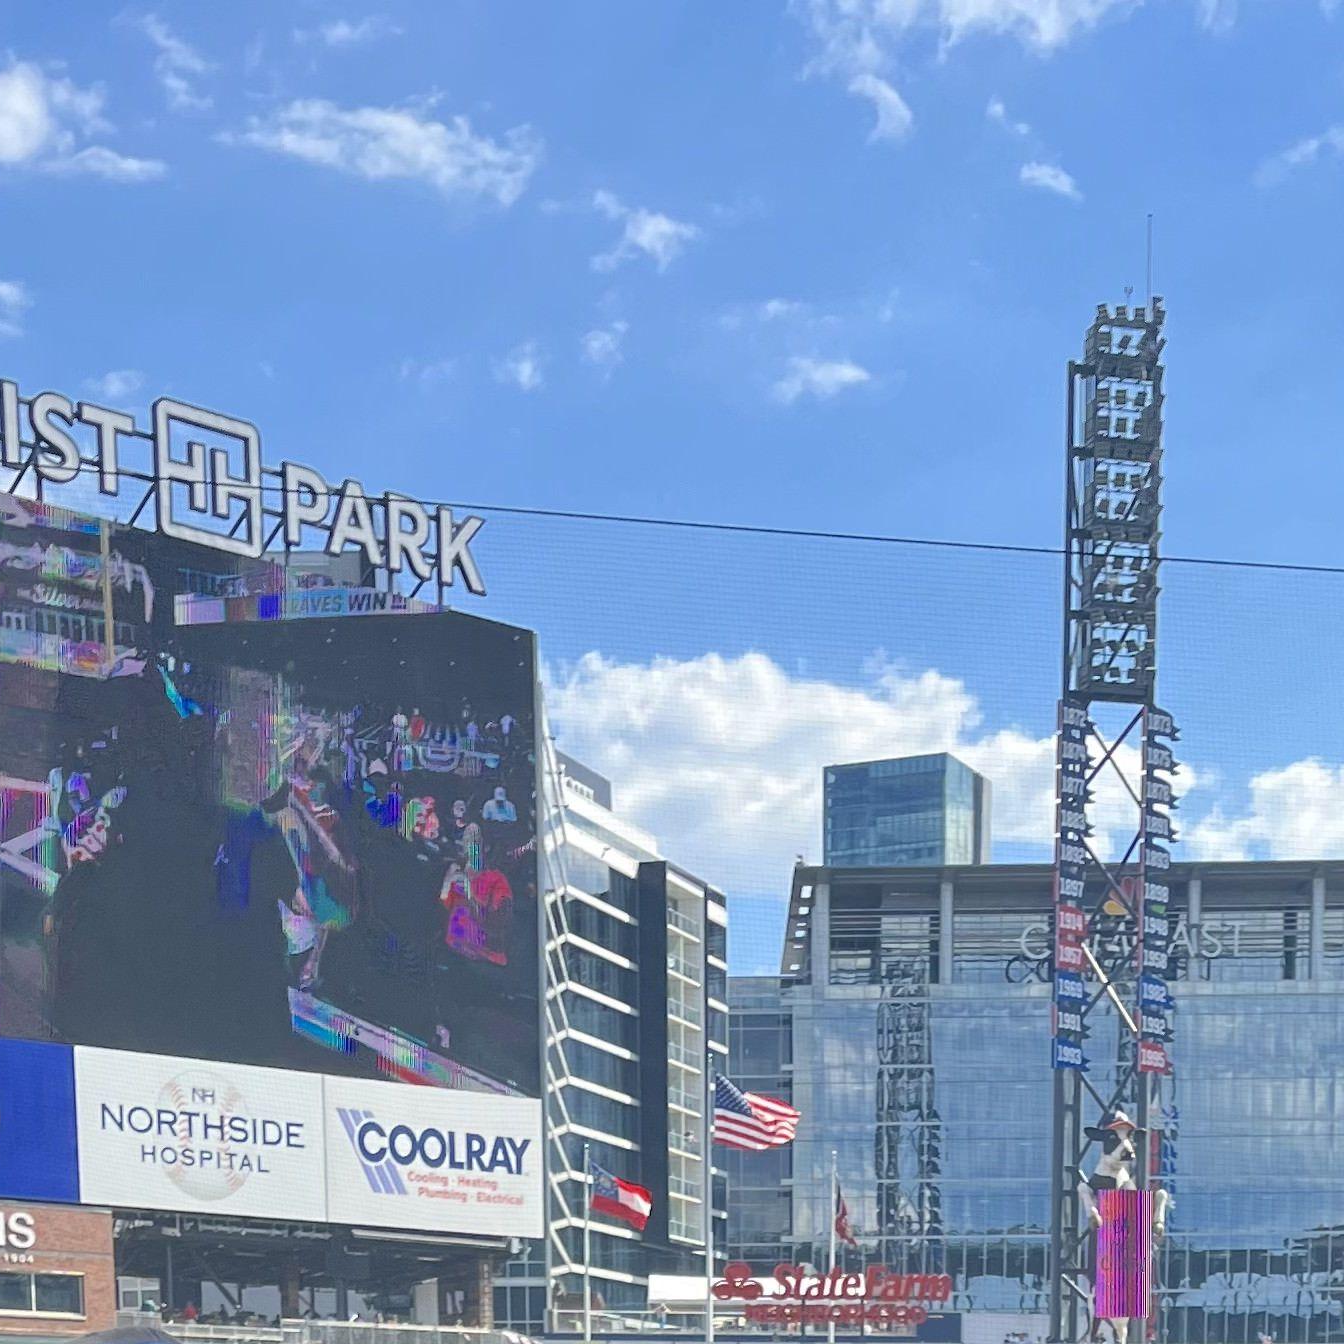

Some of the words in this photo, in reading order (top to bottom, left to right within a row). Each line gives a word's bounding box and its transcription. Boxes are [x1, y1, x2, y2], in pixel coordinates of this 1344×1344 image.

[281, 461, 487, 597] PARK
[293, 593, 343, 614] AVES
[1060, 877, 1084, 898] 1897
[1059, 911, 1083, 932] 1914
[1058, 1012, 1081, 1032] 1991
[1142, 1015, 1166, 1035] 1992
[1056, 1045, 1082, 1065] 1993
[1141, 1048, 1165, 1068] 1995
[100, 1102, 306, 1149] NORTHSIDE
[357, 1120, 532, 1176] COOLRAY
[140, 1144, 271, 1174] HOSPITAL
[407, 1171, 449, 1188] Cooling
[457, 1176, 498, 1193] Heating
[418, 1187, 467, 1204] Plumbing
[475, 1192, 525, 1207] Electrical
[745, 1304, 928, 1324] NEIGHBORHOOD
